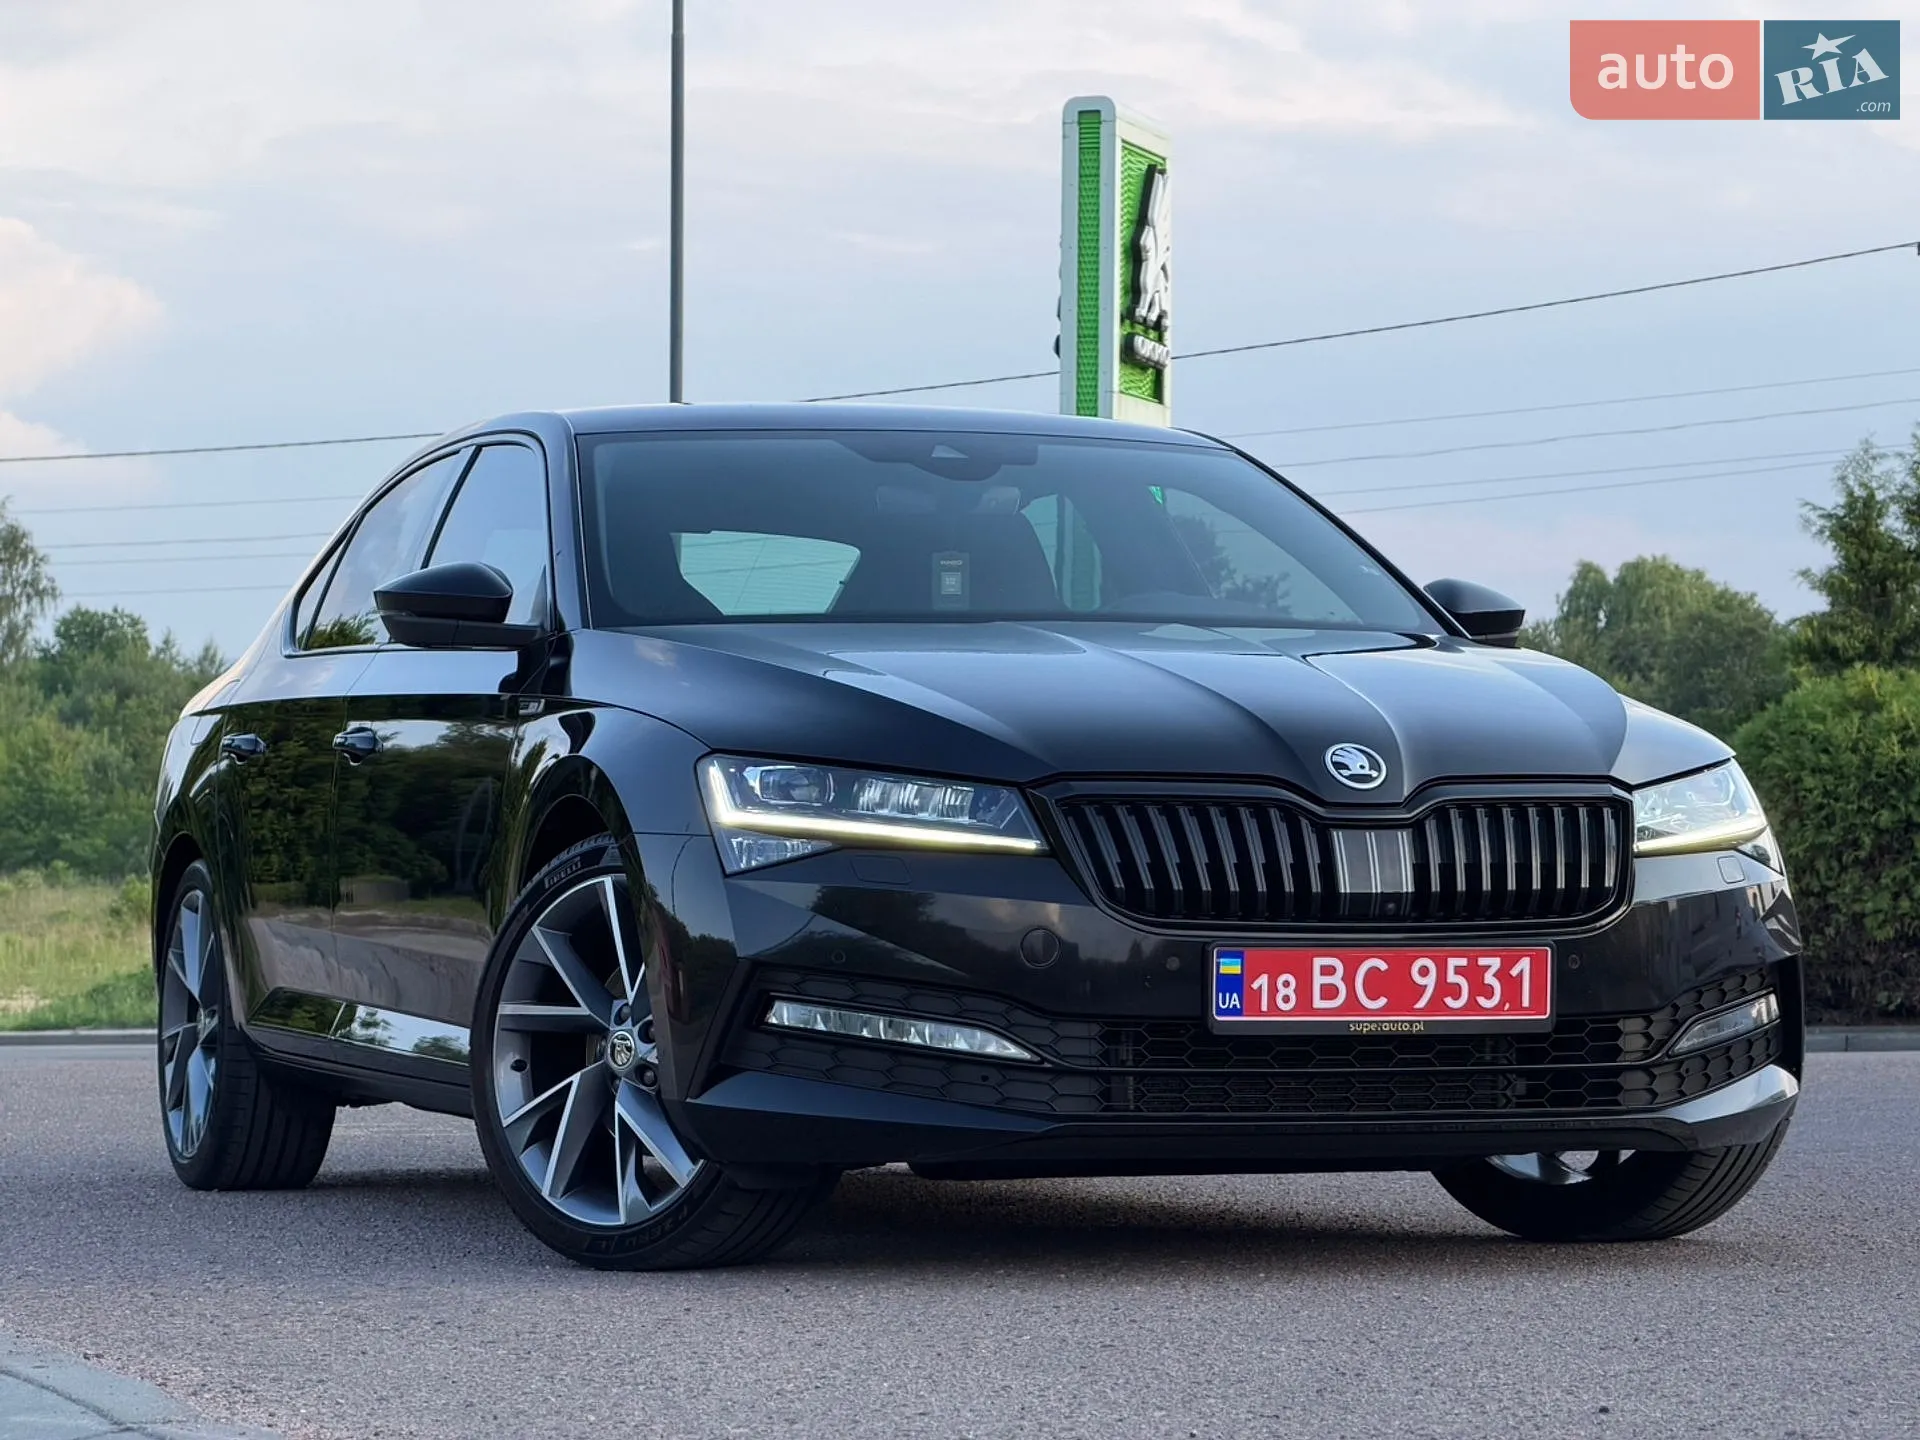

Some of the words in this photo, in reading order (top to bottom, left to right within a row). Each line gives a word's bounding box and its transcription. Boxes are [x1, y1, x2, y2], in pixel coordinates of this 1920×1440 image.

[1218, 992, 1241, 1010] UA
[1250, 973, 1298, 1013] 18
[1312, 957, 1389, 1011] BC
